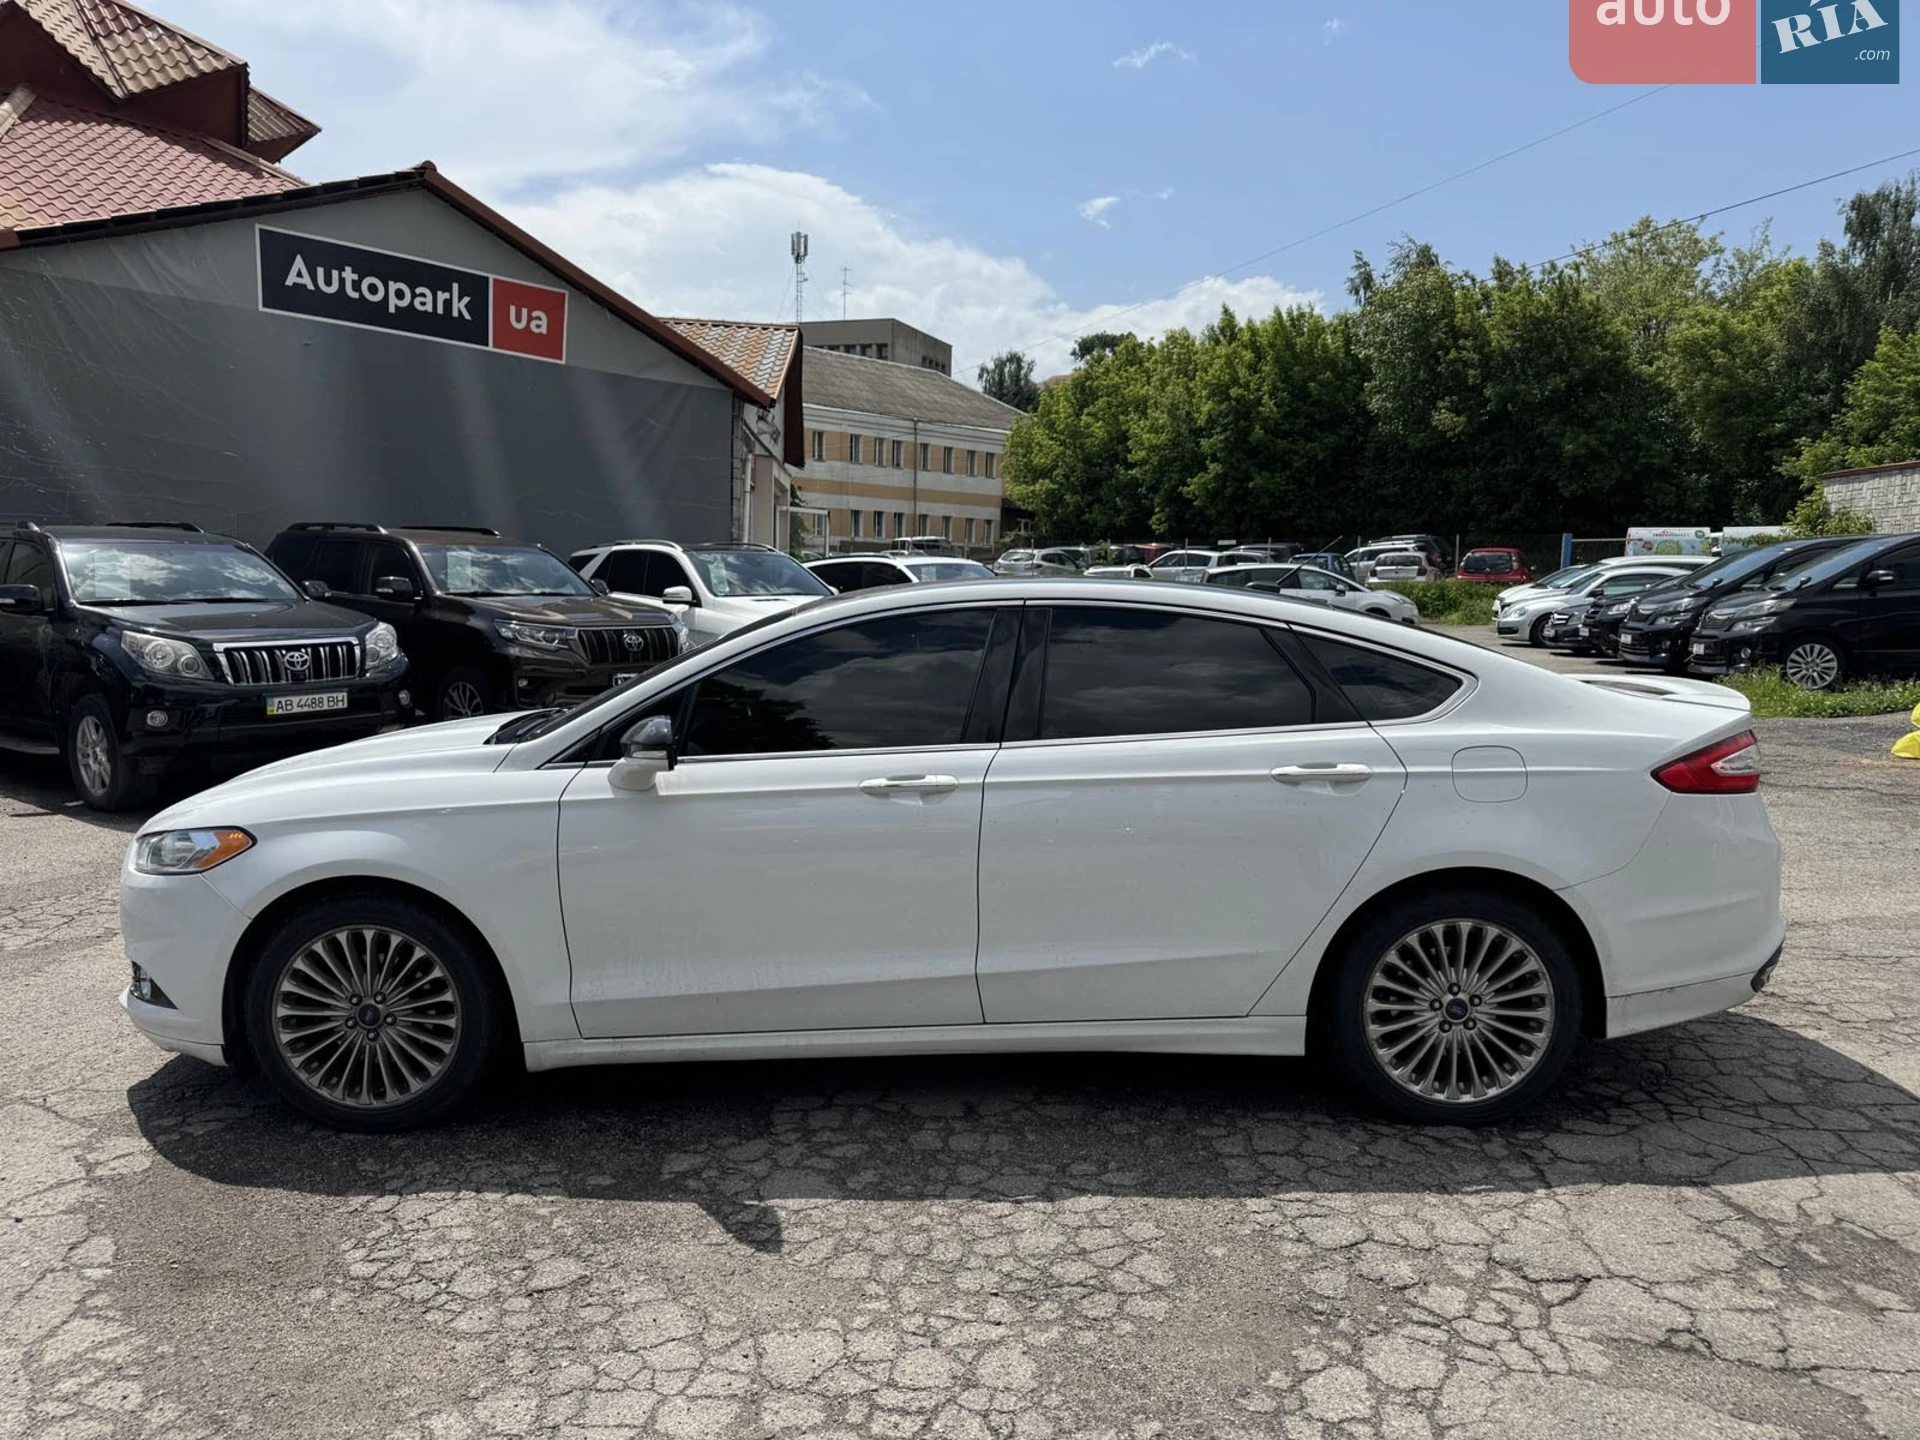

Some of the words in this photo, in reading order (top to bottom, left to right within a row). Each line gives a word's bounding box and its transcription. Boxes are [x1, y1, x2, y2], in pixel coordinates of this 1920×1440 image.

[284, 254, 472, 321] Autopark
[509, 304, 548, 335] ua
[297, 696, 324, 710] 4488
